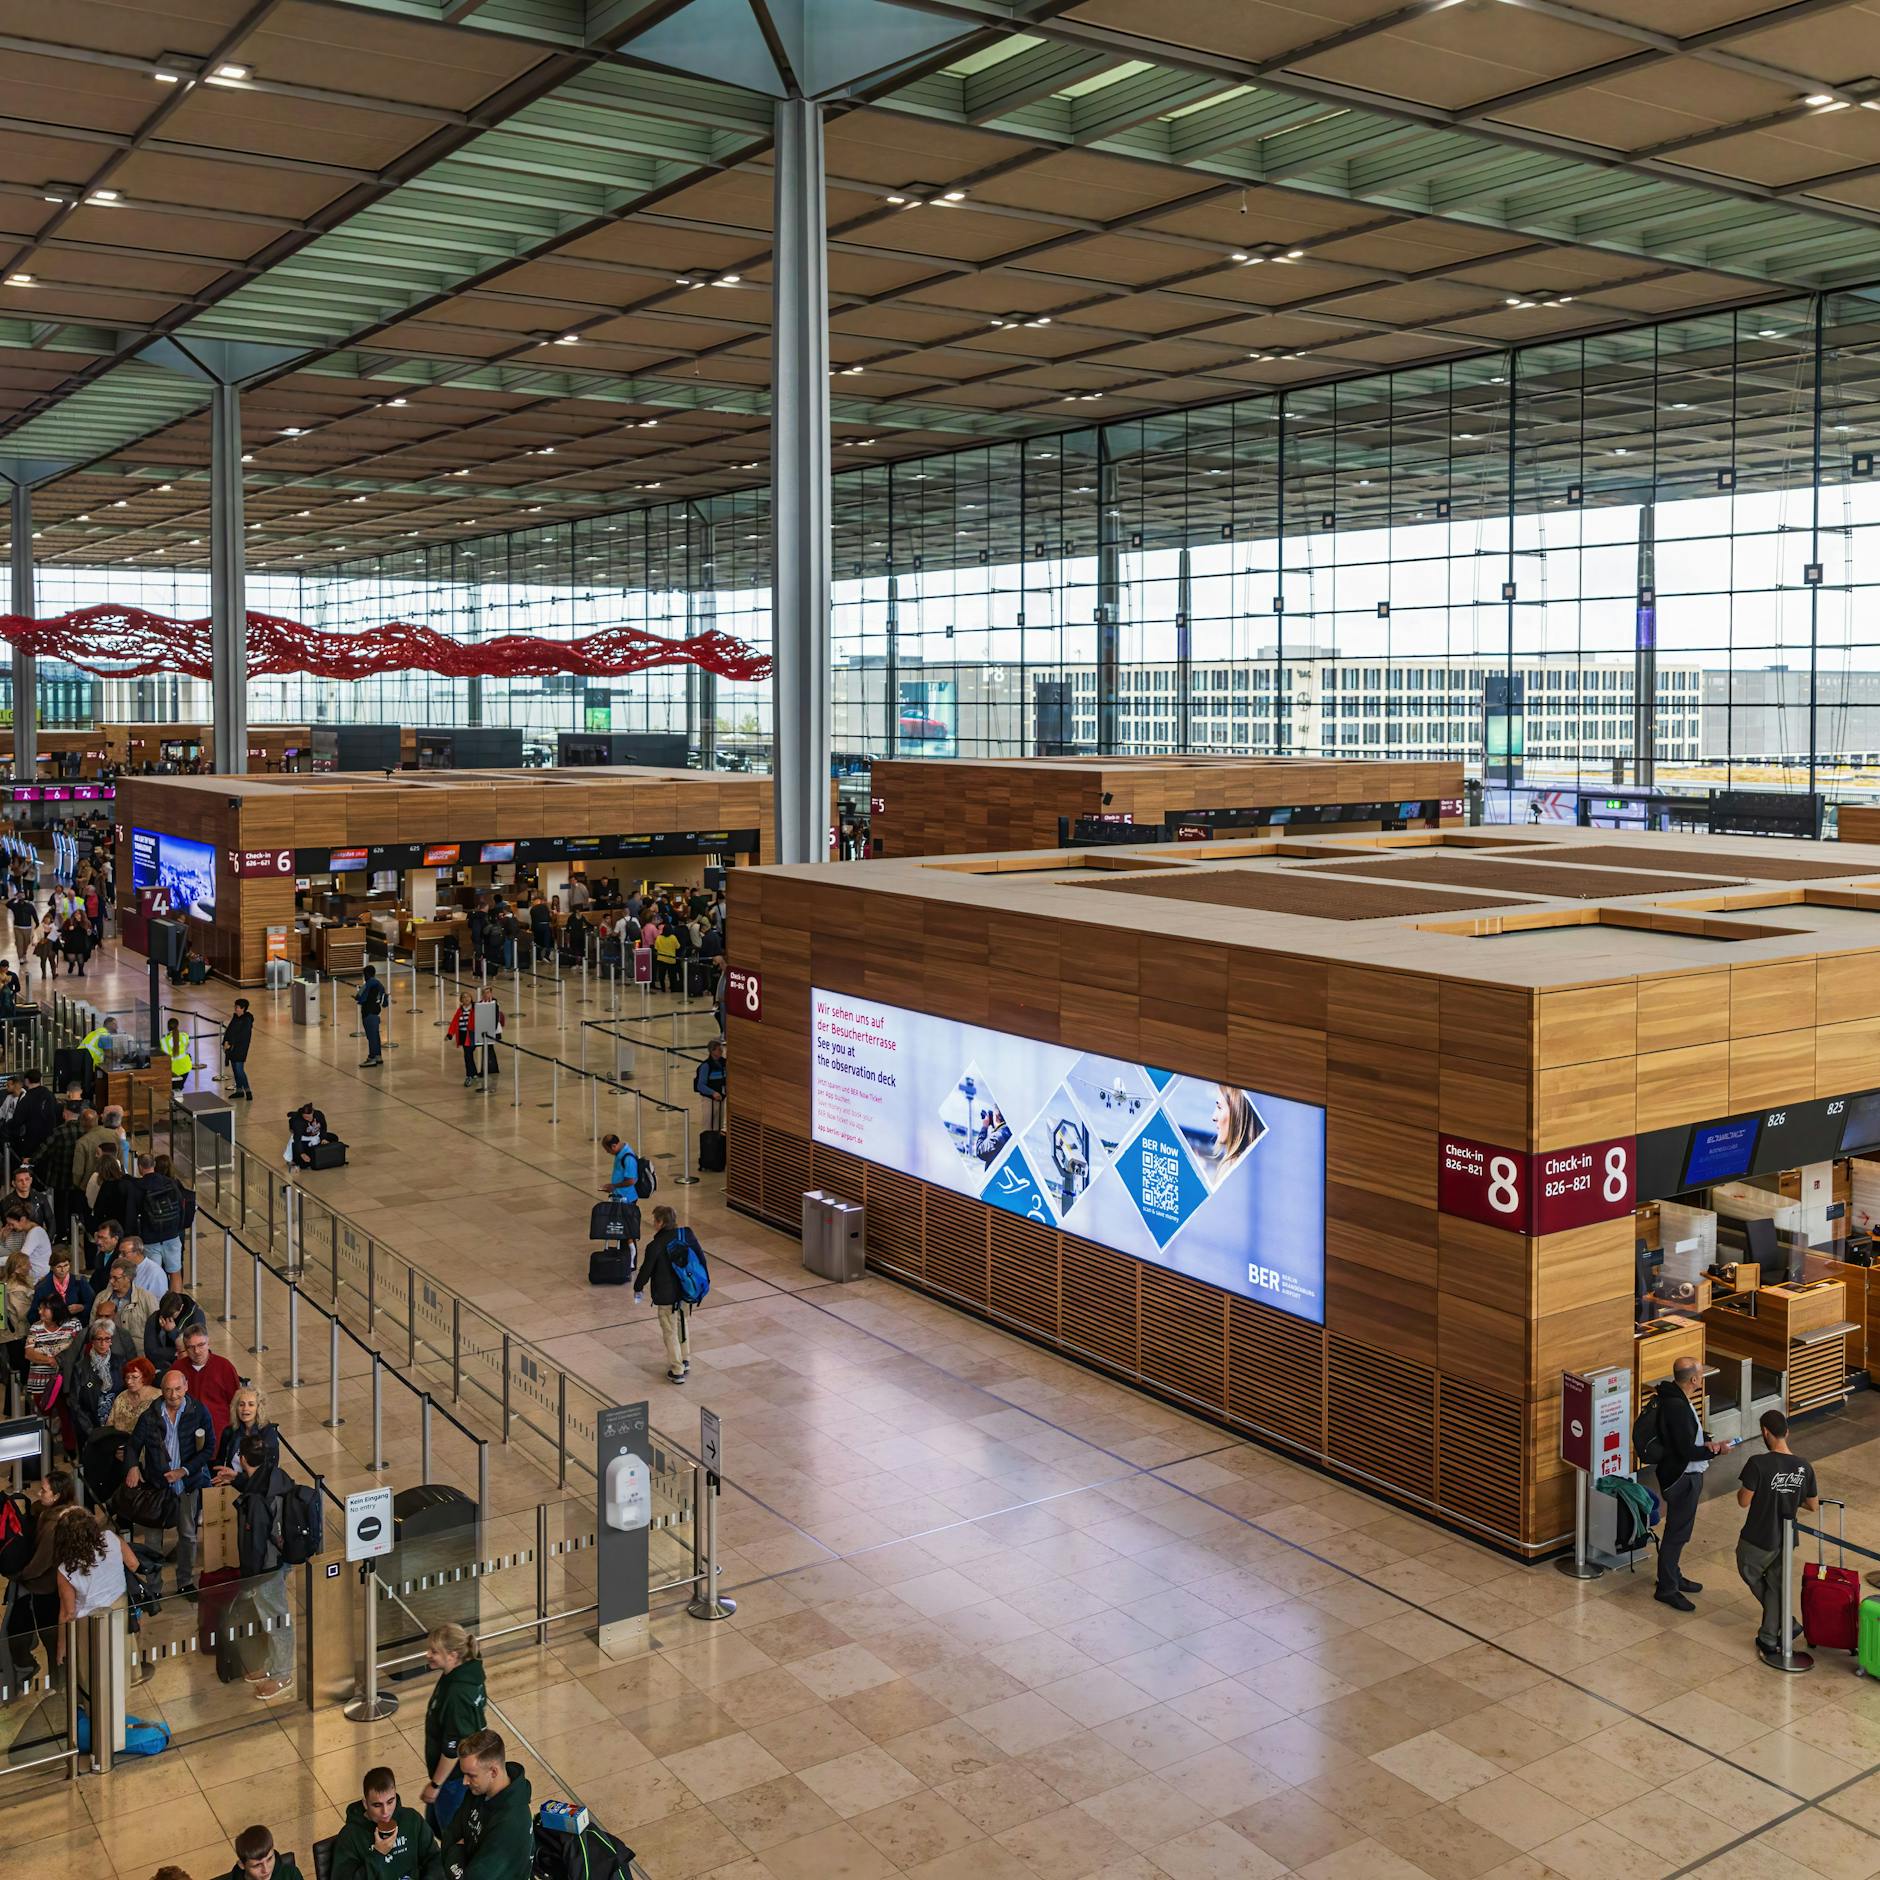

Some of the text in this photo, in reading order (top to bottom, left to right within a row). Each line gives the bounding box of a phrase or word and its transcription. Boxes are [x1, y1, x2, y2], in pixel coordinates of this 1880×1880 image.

[879, 798, 885, 812] 5
[1455, 800, 1463, 814] 5
[245, 852, 272, 860] Check-in
[277, 851, 291, 872] 6
[152, 892, 170, 916] 4
[730, 971, 759, 1012] Check-in 8
[817, 1002, 885, 1030] Wir sehen uns auf
[817, 1020, 897, 1051] der Besucherterrasse
[817, 1036, 856, 1058] See you at
[817, 1053, 897, 1088] the observation deck
[1827, 1100, 1845, 1115] 825
[1767, 1112, 1787, 1128] 826
[1142, 1137, 1179, 1157] BER Now
[1446, 1144, 1519, 1213] Check-in 8
[1545, 1146, 1628, 1202] Check-in 8
[1248, 1262, 1280, 1292] BER
[360, 1503, 376, 1511] entry
[364, 1493, 389, 1502] Eingang
